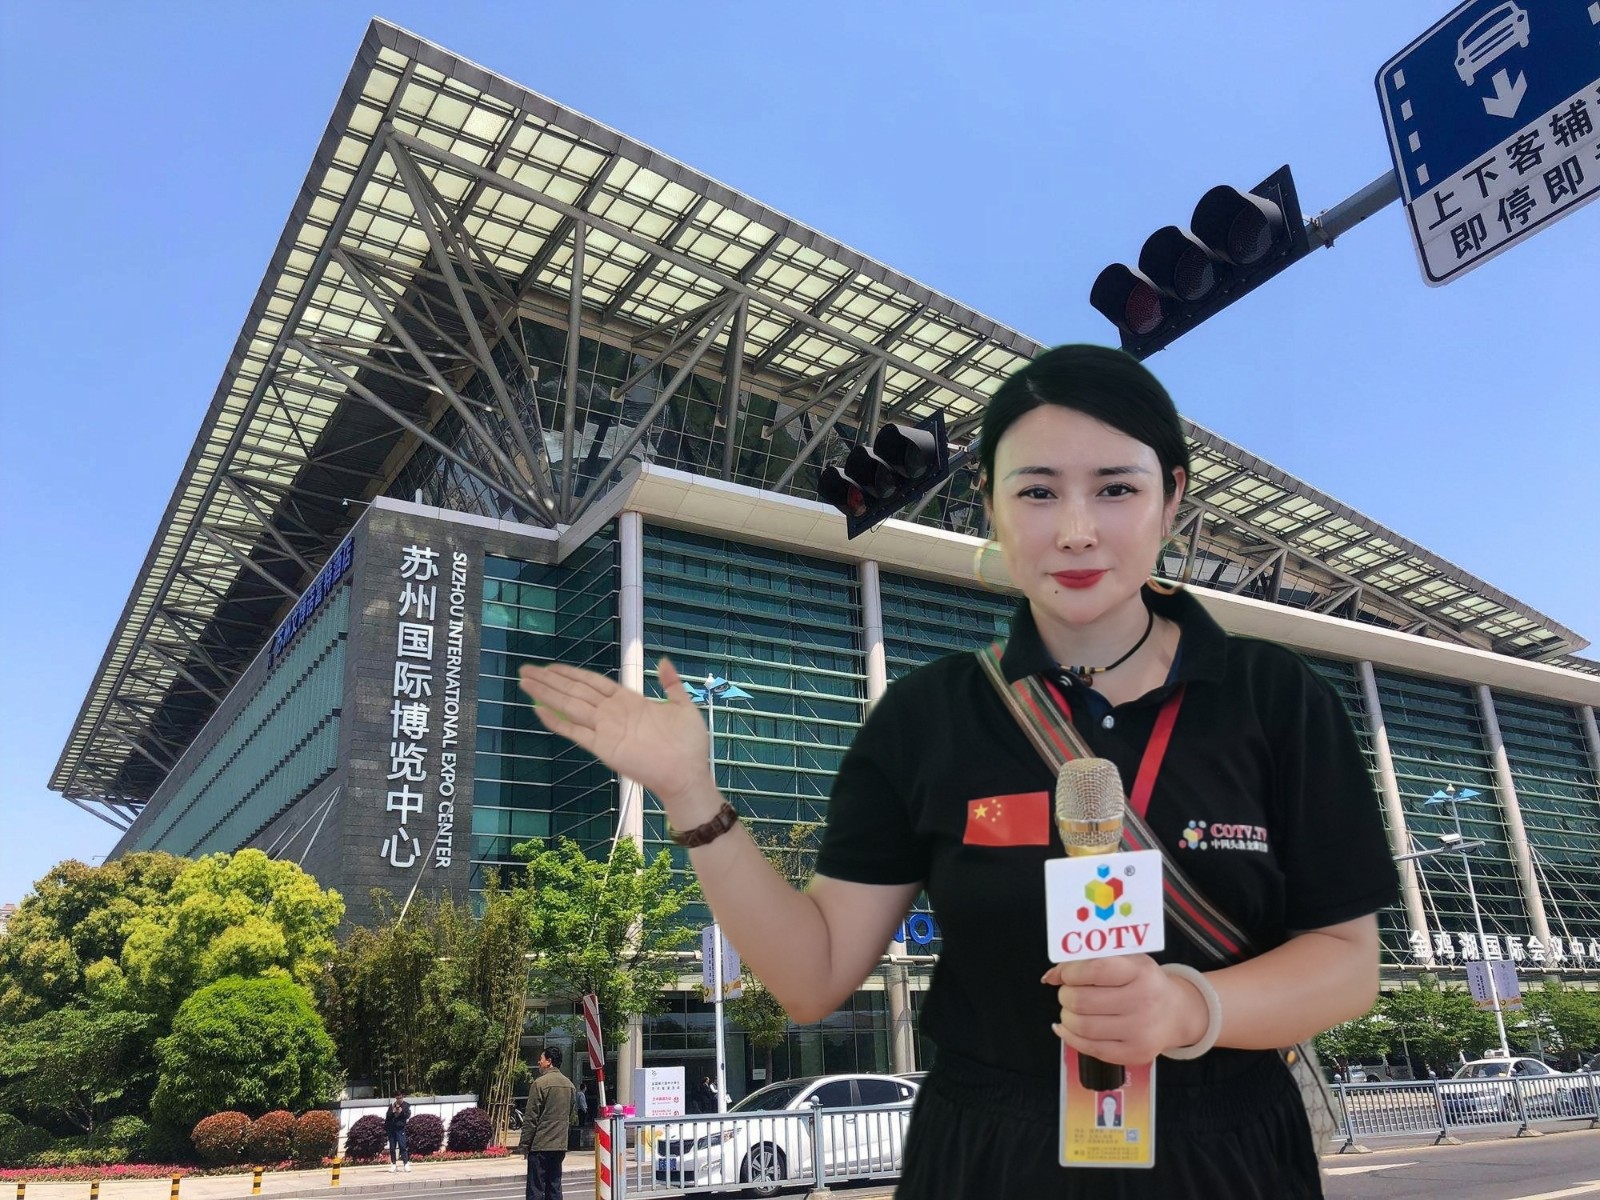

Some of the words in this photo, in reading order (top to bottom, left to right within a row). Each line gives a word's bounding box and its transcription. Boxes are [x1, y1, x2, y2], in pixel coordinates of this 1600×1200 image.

[1428, 86, 1600, 231] 上下客辅
[1449, 143, 1600, 259] 即停即
[450, 551, 468, 618] SUZHOU
[380, 545, 440, 869] 苏州国际博览中心
[442, 619, 464, 749] INTERNATIONAL
[438, 752, 457, 797] EXPO
[434, 801, 454, 869] CENTER
[1061, 923, 1151, 954] COTV
